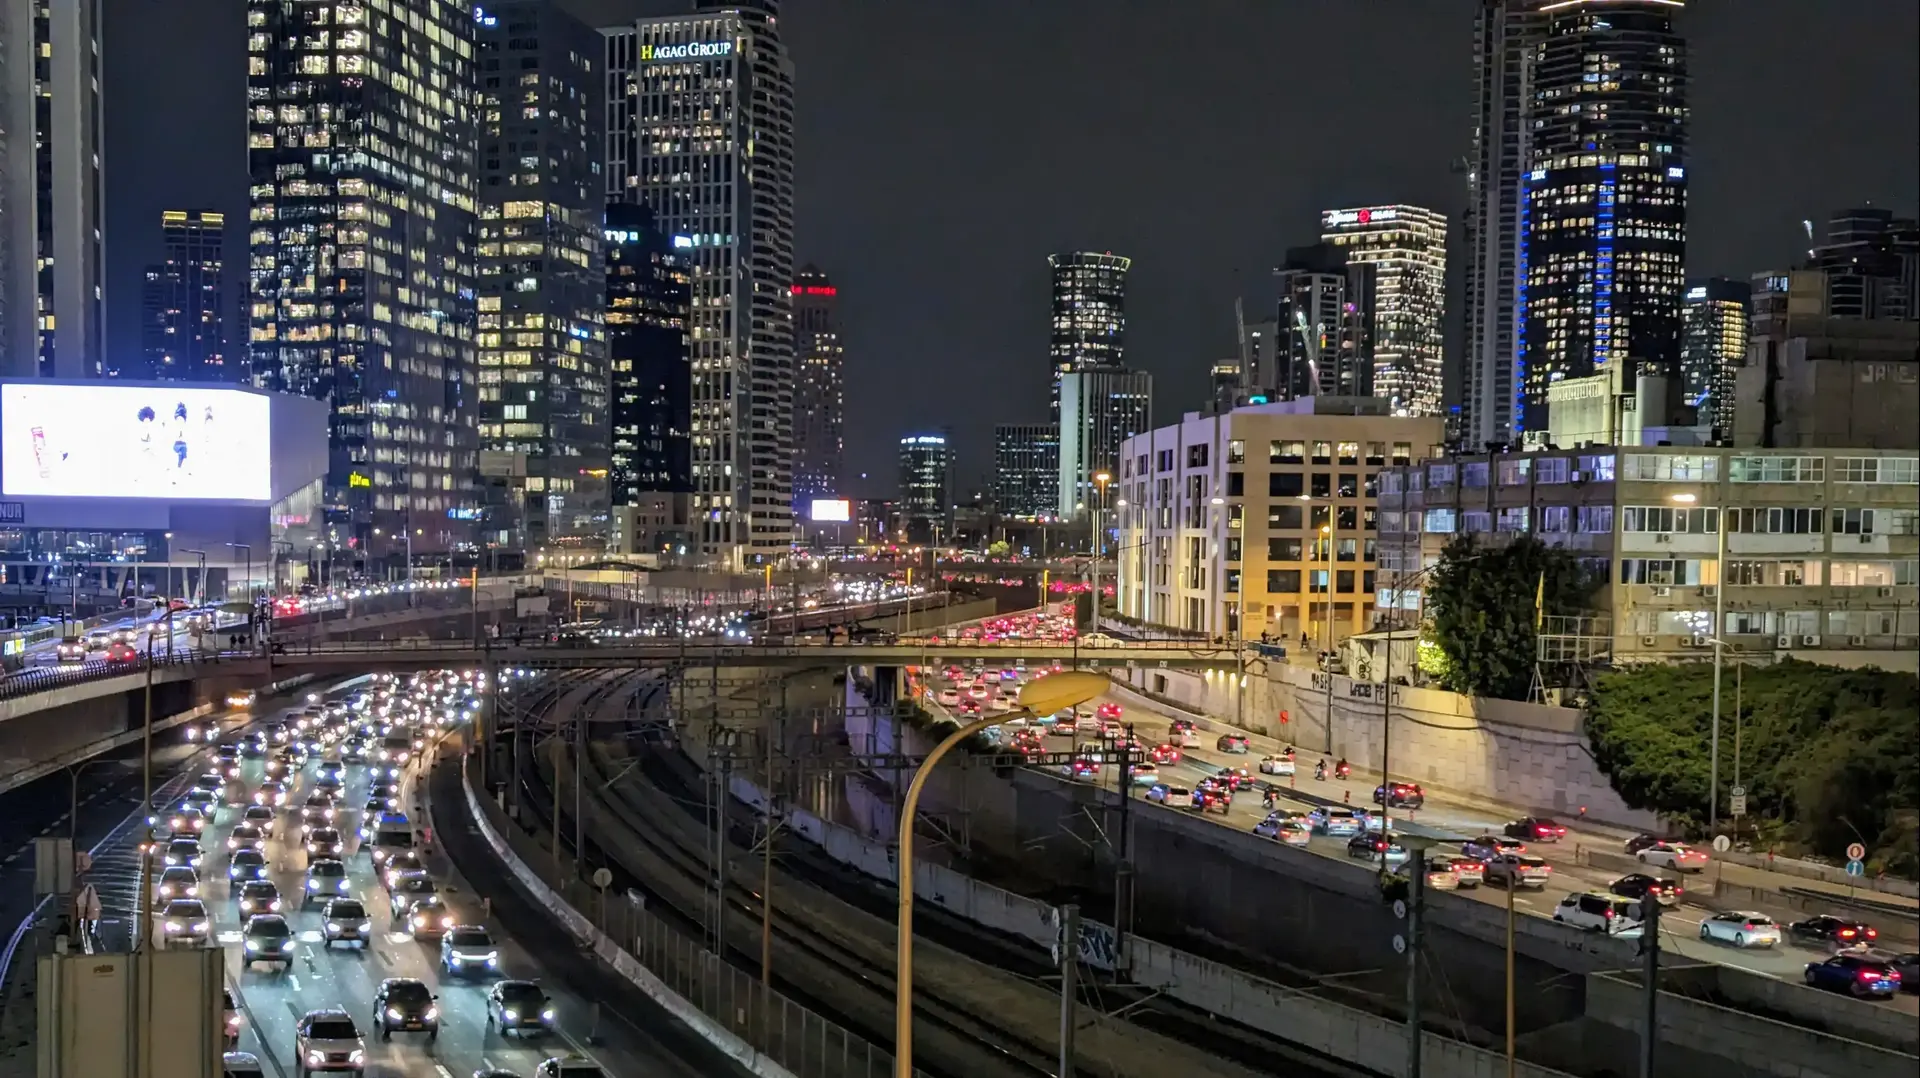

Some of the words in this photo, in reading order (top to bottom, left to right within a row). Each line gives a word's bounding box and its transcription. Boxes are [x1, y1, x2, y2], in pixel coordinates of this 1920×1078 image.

[641, 45, 687, 60] HAGAG
[687, 42, 731, 57] GROUP
[1531, 169, 1546, 181] IBM
[1668, 167, 1683, 178] IBM
